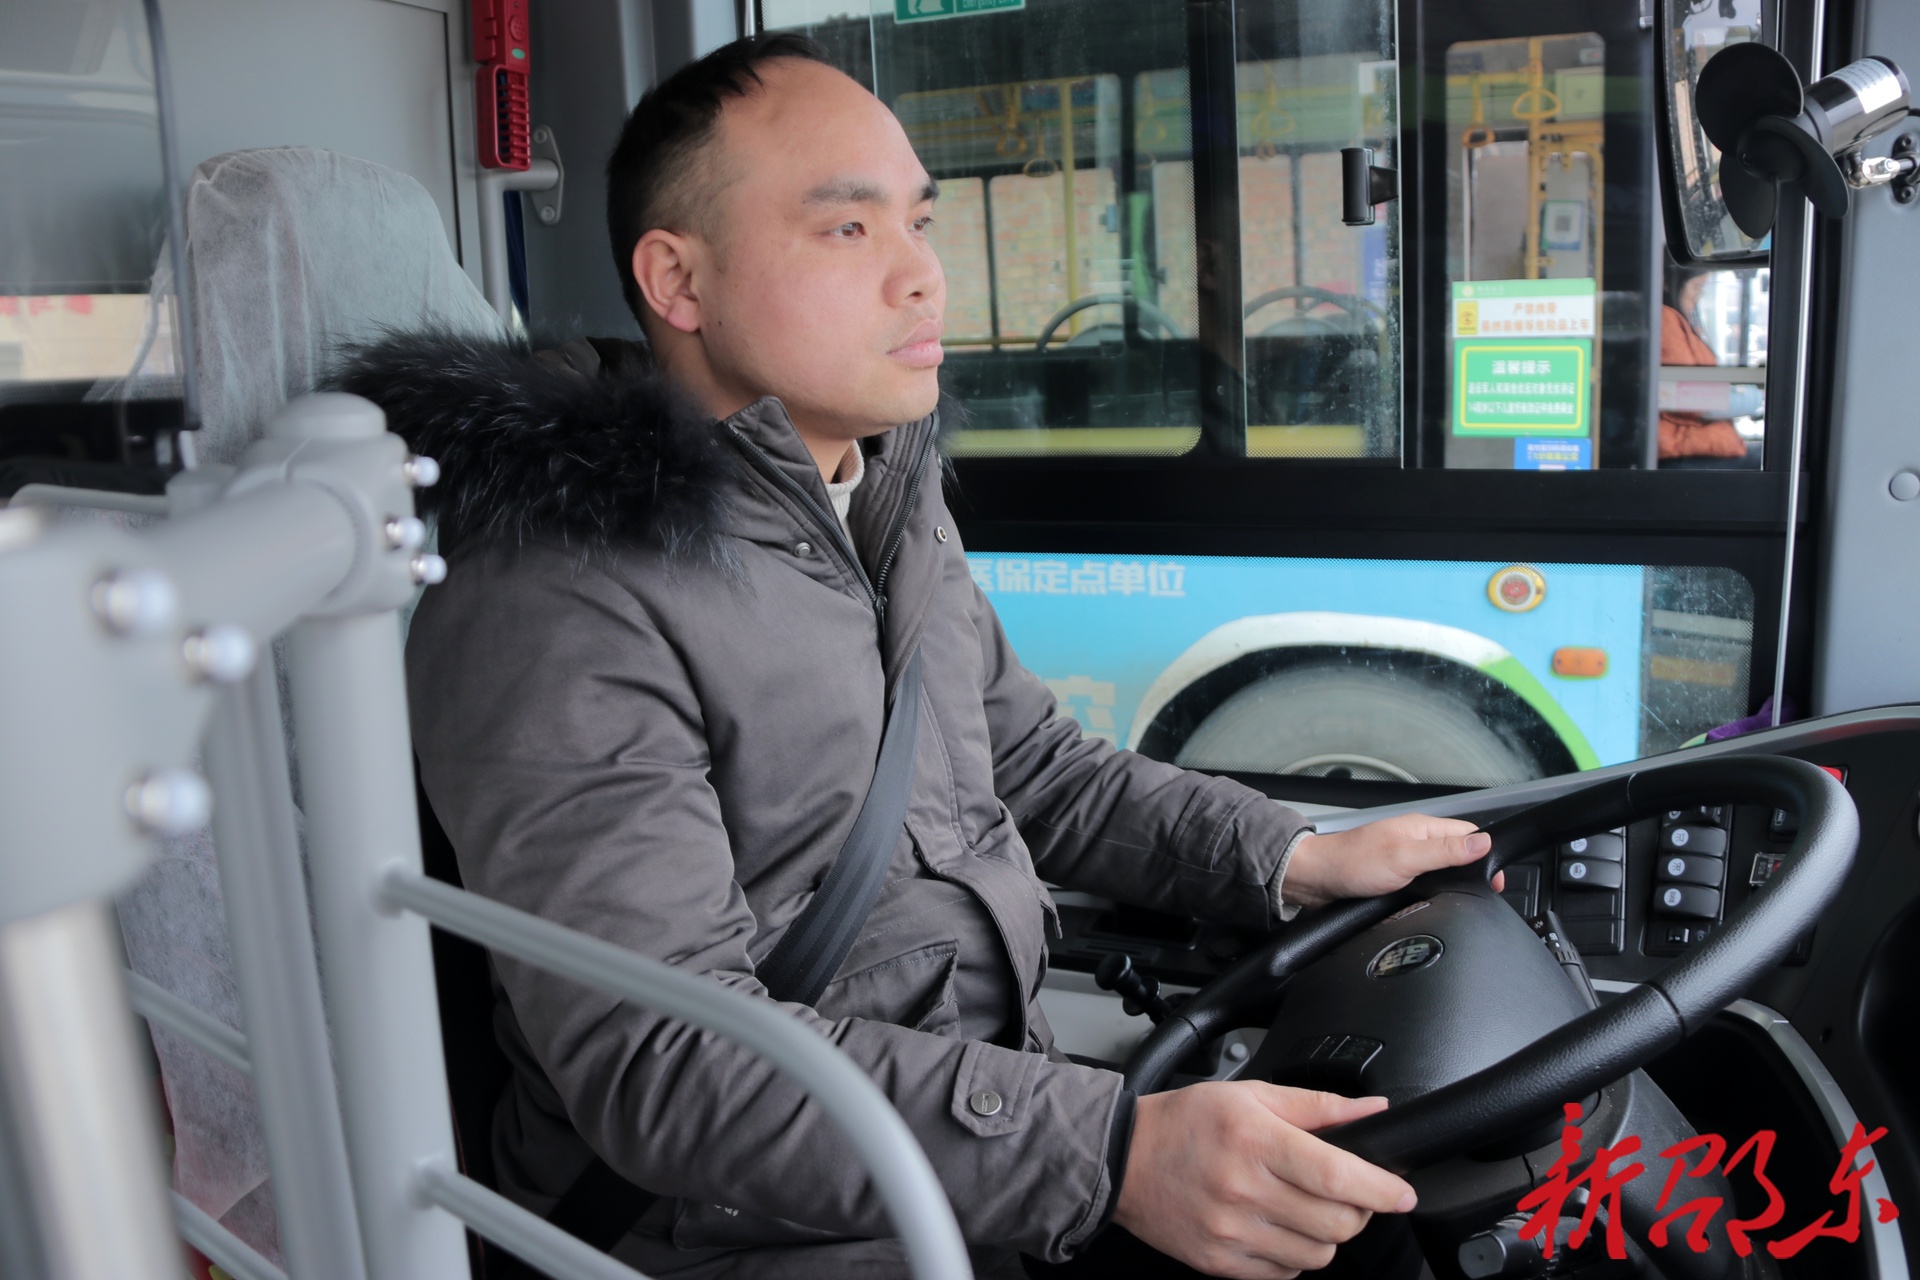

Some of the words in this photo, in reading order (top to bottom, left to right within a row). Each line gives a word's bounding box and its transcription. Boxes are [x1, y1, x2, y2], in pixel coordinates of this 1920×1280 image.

[1492, 360, 1551, 375] 温馨提示
[969, 559, 1185, 597] 医保定点单位
